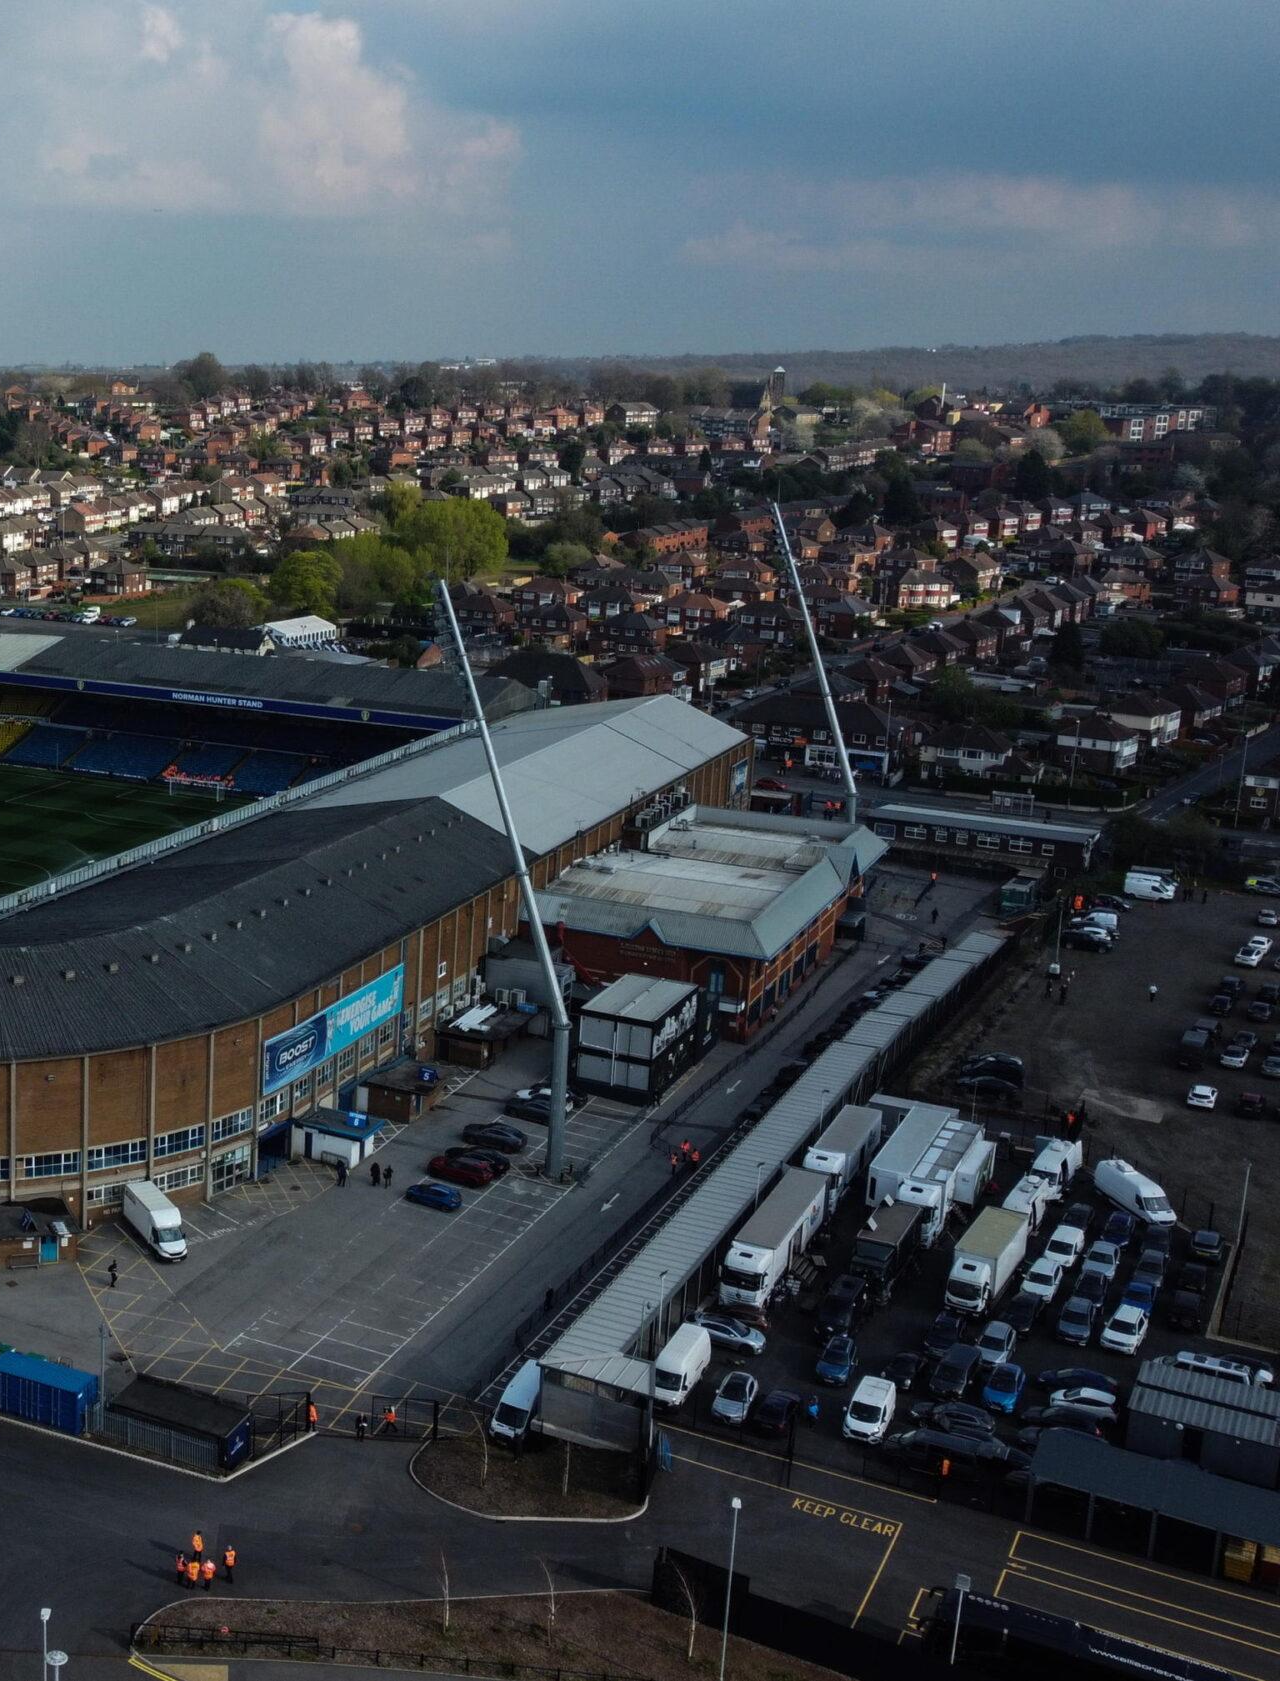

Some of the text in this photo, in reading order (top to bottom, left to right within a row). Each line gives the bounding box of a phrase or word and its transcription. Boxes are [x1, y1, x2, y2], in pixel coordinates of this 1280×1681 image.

[172, 691, 264, 709] NORMAN HUNTER STAND
[278, 1035, 316, 1066] BOOST
[792, 1497, 896, 1537] KEEP CLEAR
